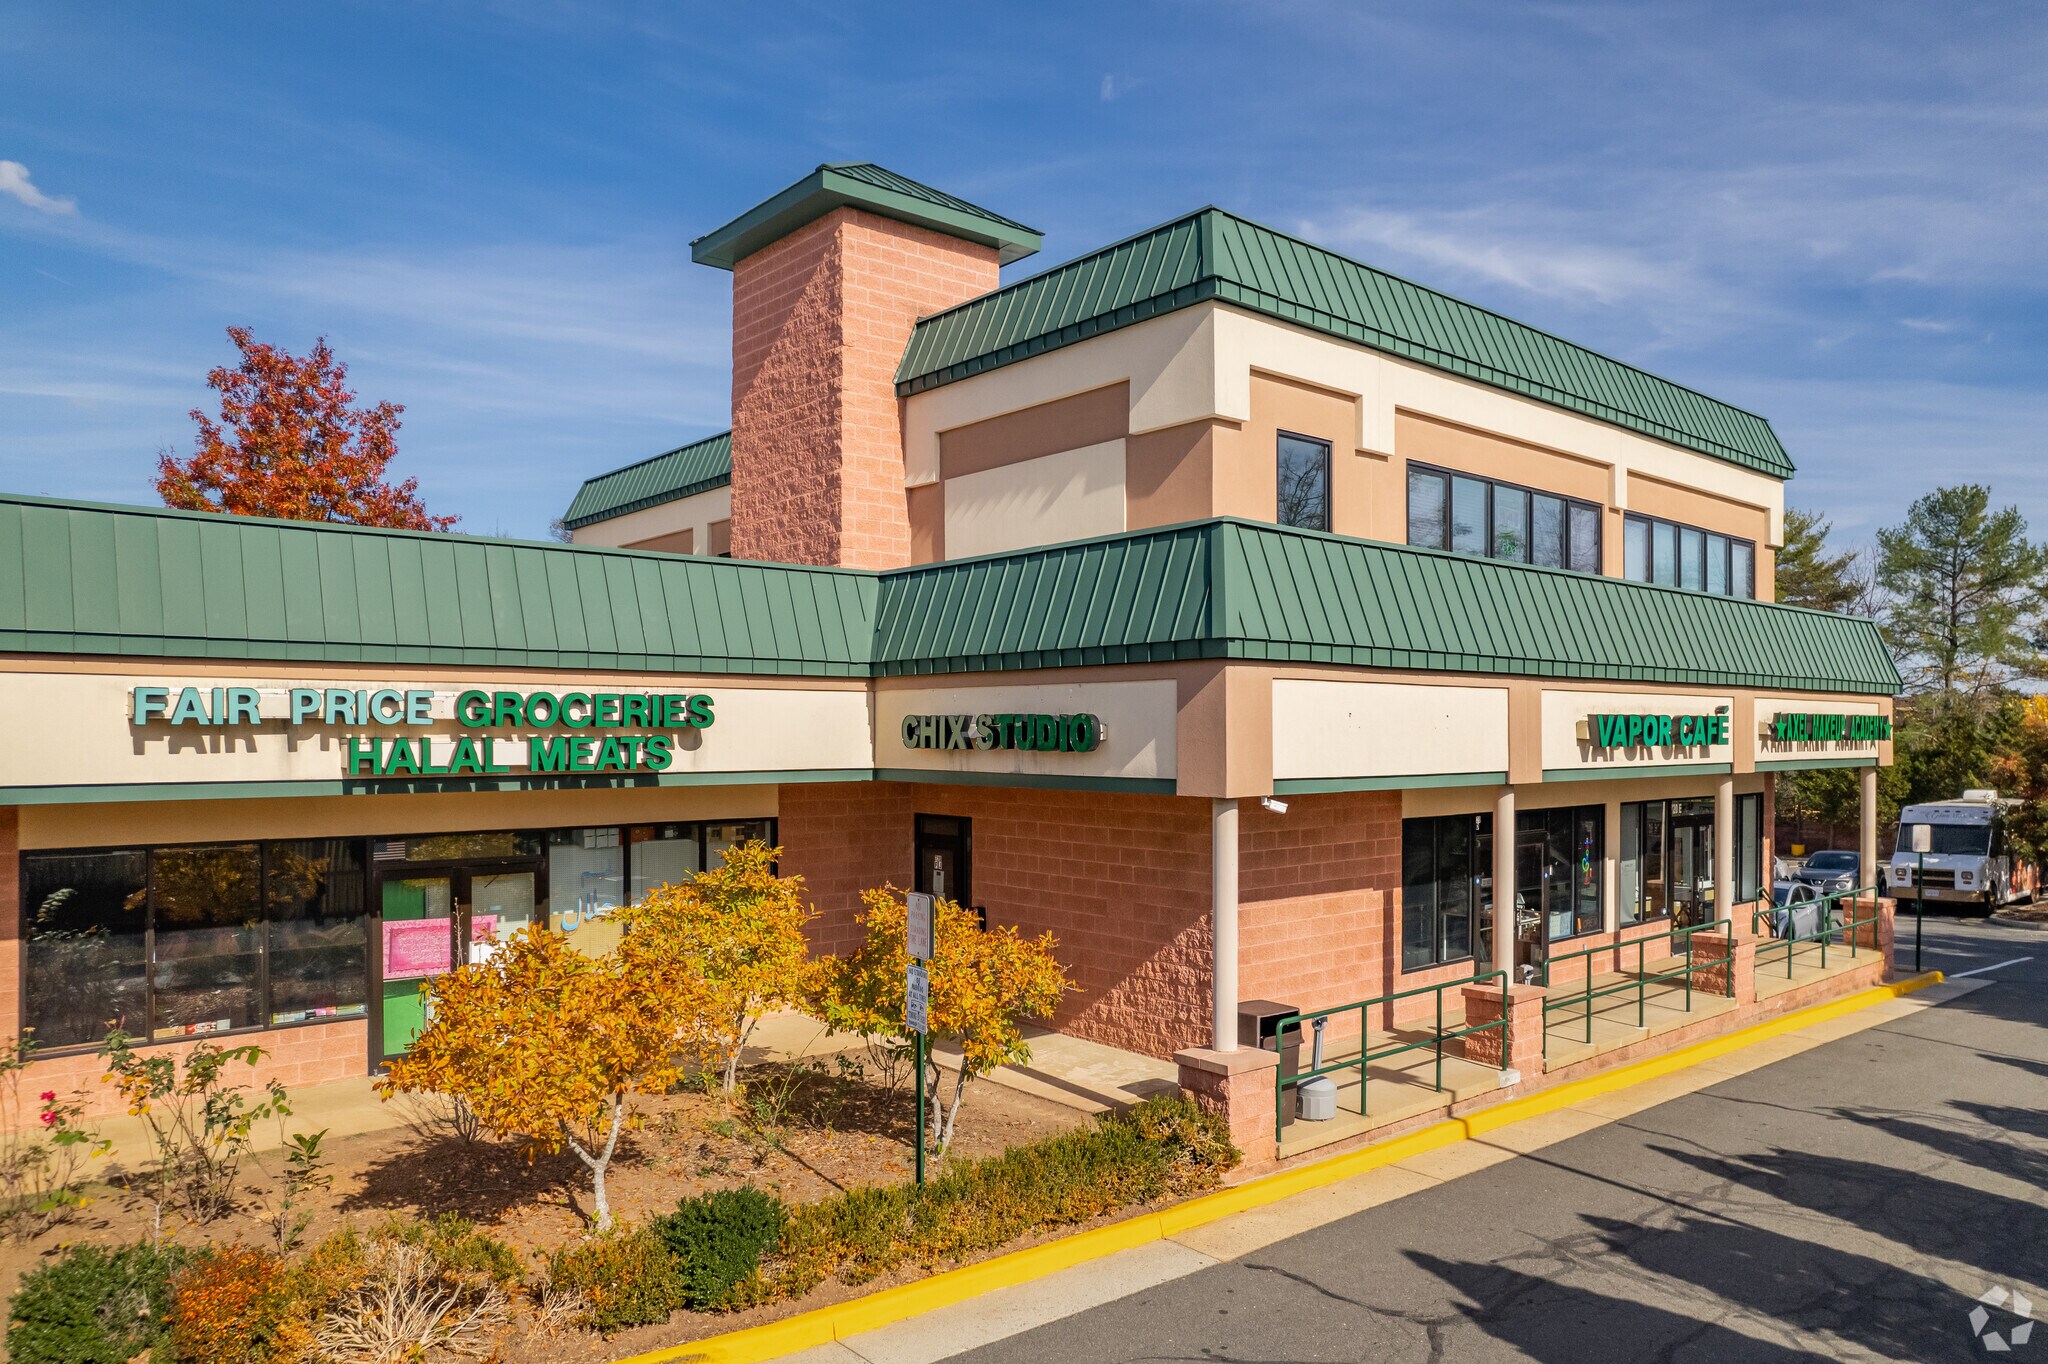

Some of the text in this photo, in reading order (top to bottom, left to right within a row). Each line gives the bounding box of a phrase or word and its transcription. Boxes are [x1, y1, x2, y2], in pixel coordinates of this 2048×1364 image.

[133, 687, 715, 728] FAIR PRICE GROCERIES
[1786, 713, 1884, 741] AXEL MAKEUP ACADEMY
[902, 713, 1094, 752] CHIX STUDIO
[1598, 714, 1672, 748] VAPOR
[350, 736, 673, 775] HALAL MEATS
